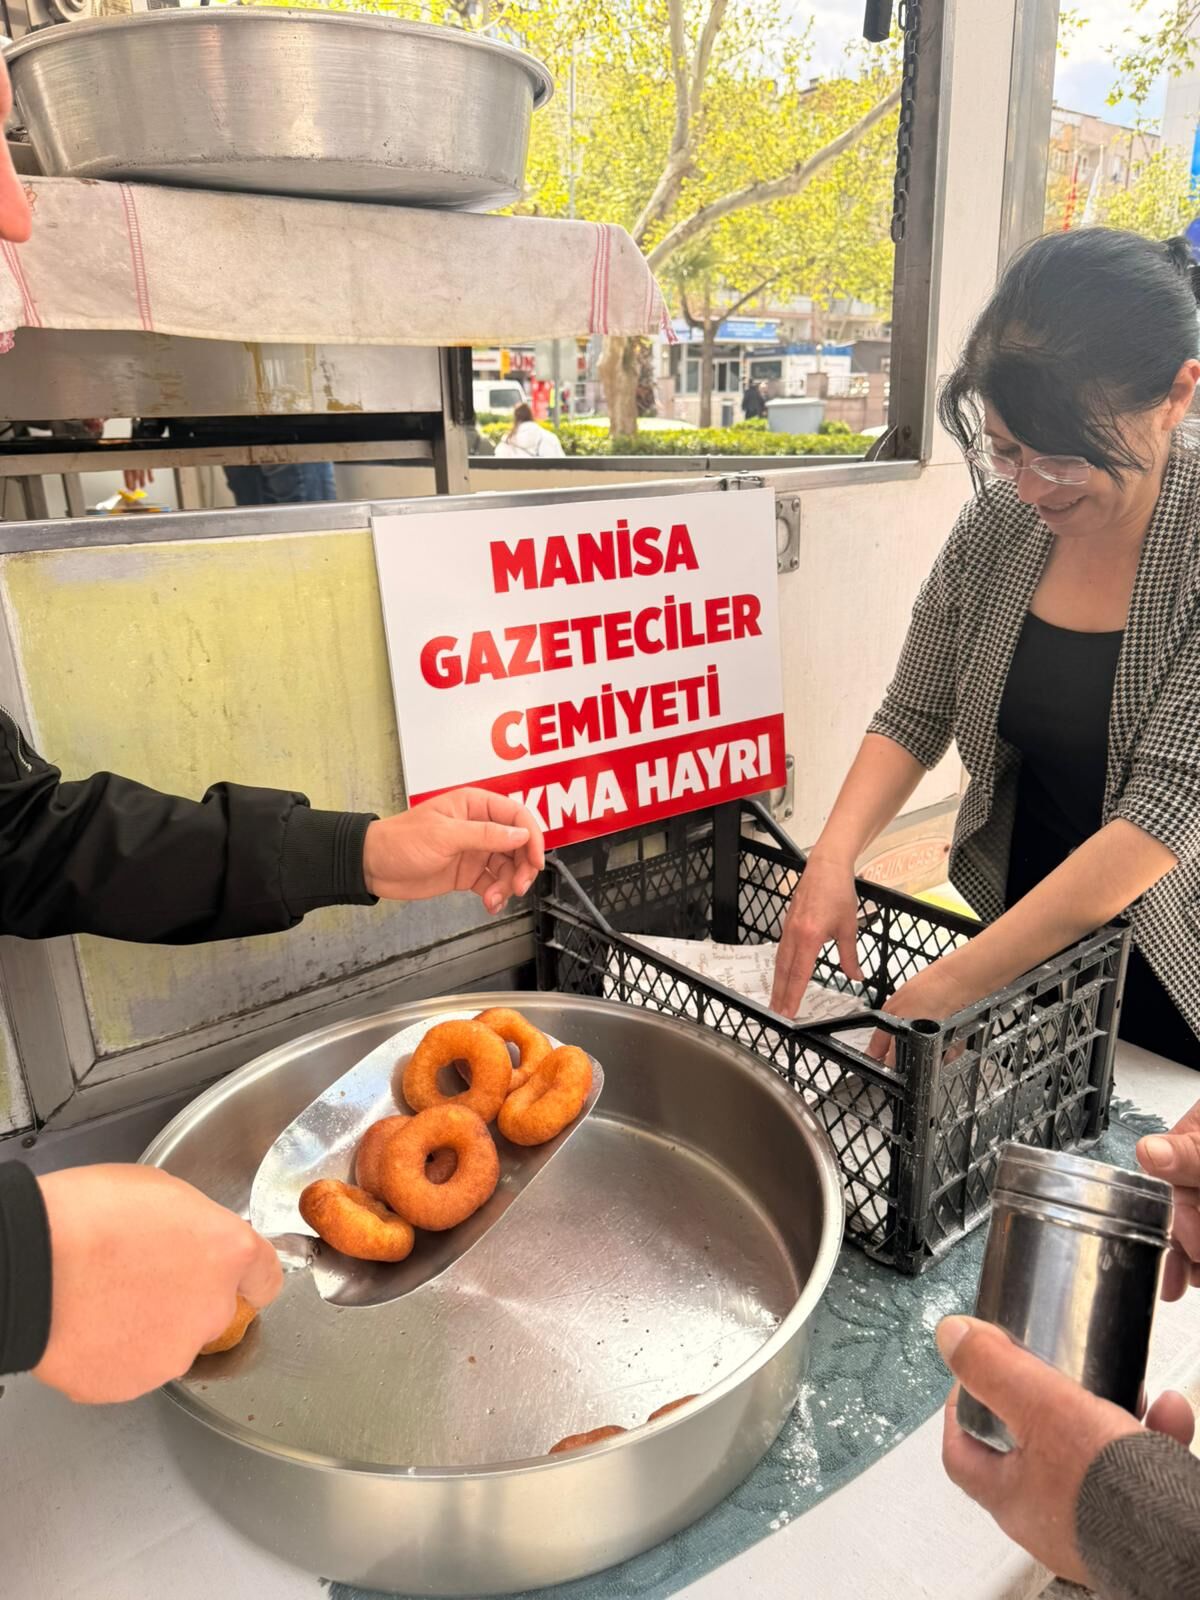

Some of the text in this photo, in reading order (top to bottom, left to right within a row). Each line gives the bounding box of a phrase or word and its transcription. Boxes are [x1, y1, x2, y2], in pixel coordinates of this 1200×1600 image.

[490, 518, 700, 594] MANİSA
[420, 594, 762, 690] GAZETECİLER
[491, 664, 721, 762] CEMİYETİ
[508, 733, 771, 833] KMA HAYRI
